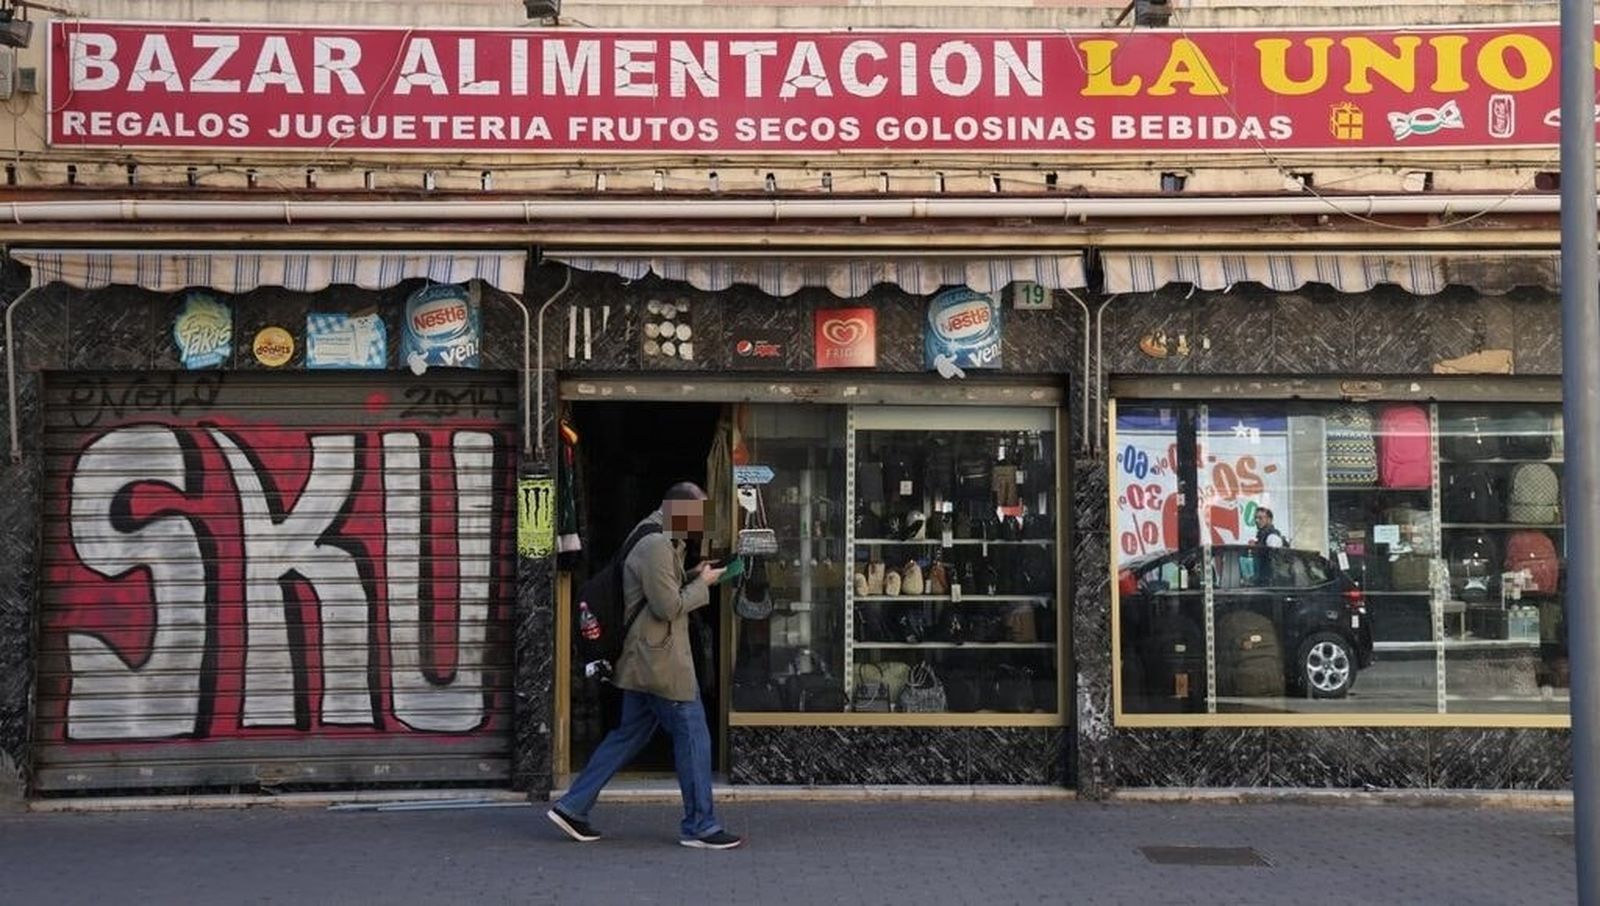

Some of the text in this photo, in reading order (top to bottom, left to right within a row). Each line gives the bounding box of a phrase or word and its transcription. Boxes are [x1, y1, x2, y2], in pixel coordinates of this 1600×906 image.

[69, 33, 1600, 98] BAZAR ALIMENTACION LA UNIO
[62, 111, 1294, 142] REGALOS JUGUETERIA FRUTOS SECOS GOLOSINAS BEBIDAS
[1022, 284, 1045, 304] 19
[64, 420, 499, 742] SKU
